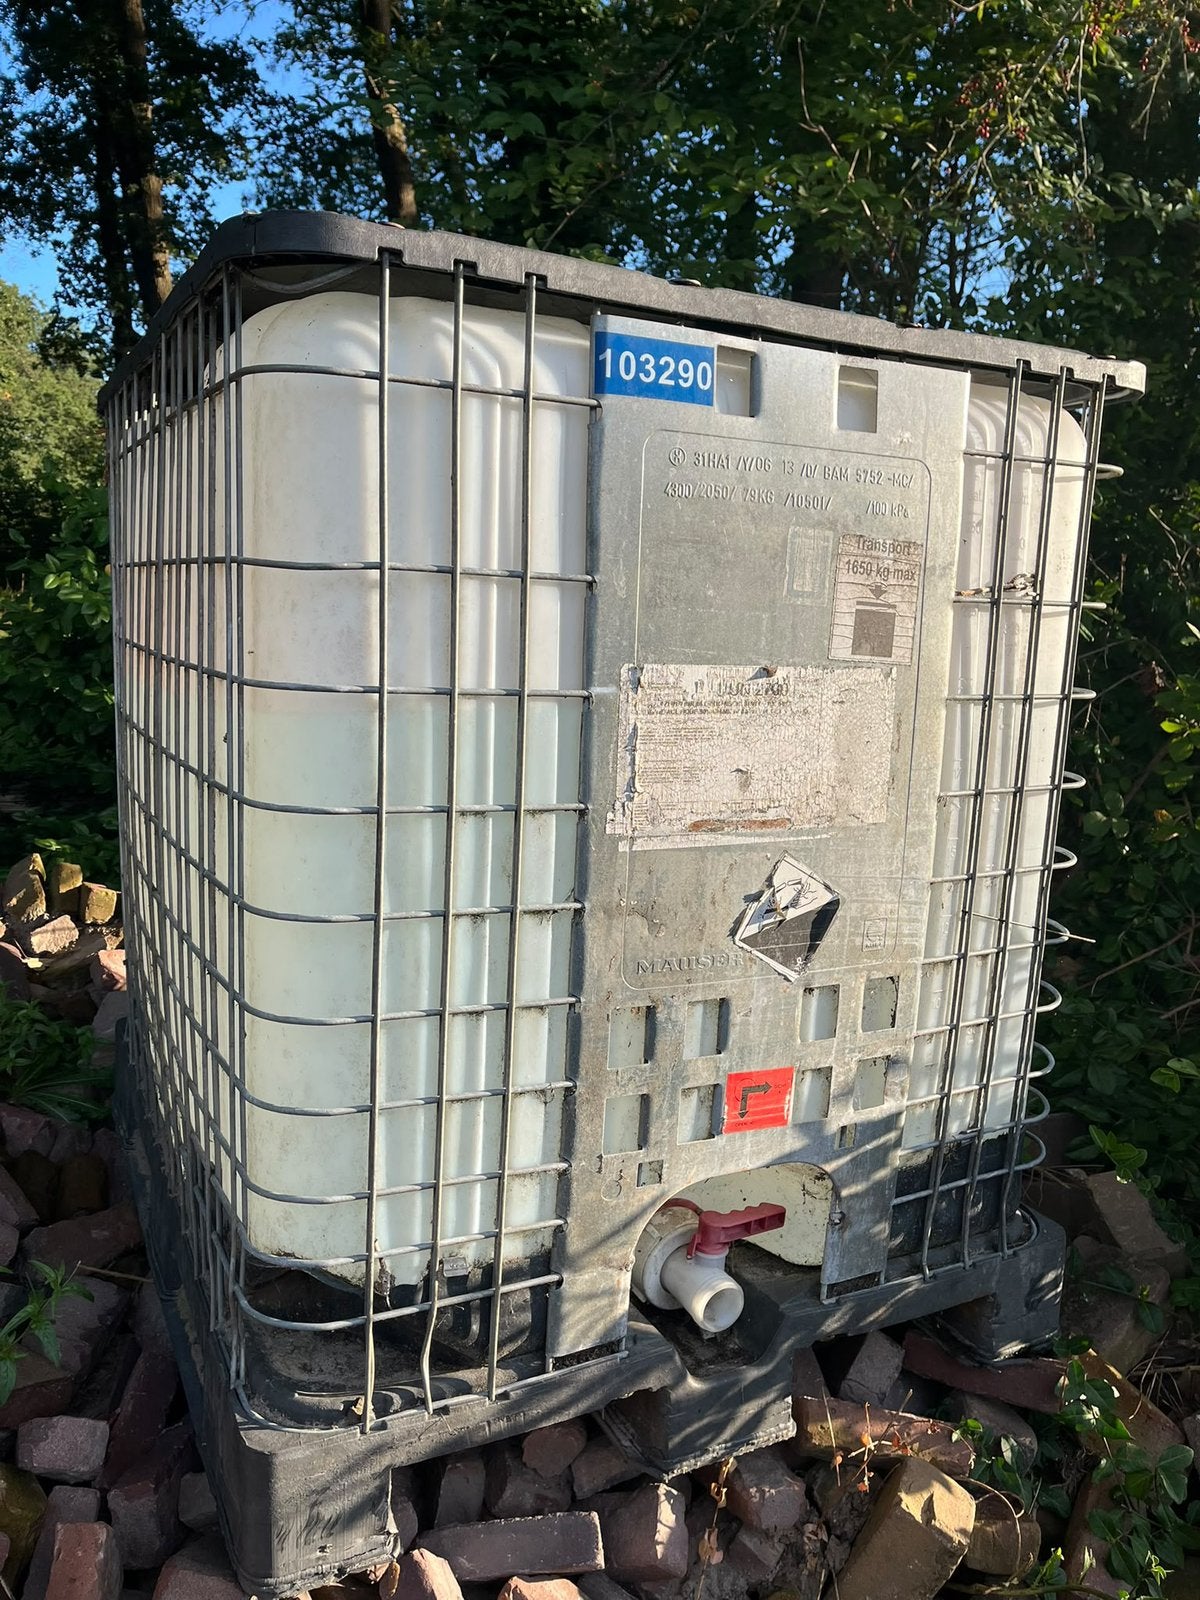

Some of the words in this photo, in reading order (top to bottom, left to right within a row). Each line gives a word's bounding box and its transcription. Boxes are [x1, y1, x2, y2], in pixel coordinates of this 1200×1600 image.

[598, 347, 713, 391] 103290
[823, 464, 850, 482] BAM
[856, 467, 884, 486] 5752
[856, 536, 912, 557] Transport
[845, 558, 873, 577] 1650
[875, 562, 890, 581] kg
[892, 568, 917, 581] max
[636, 951, 745, 975] MAUSER
